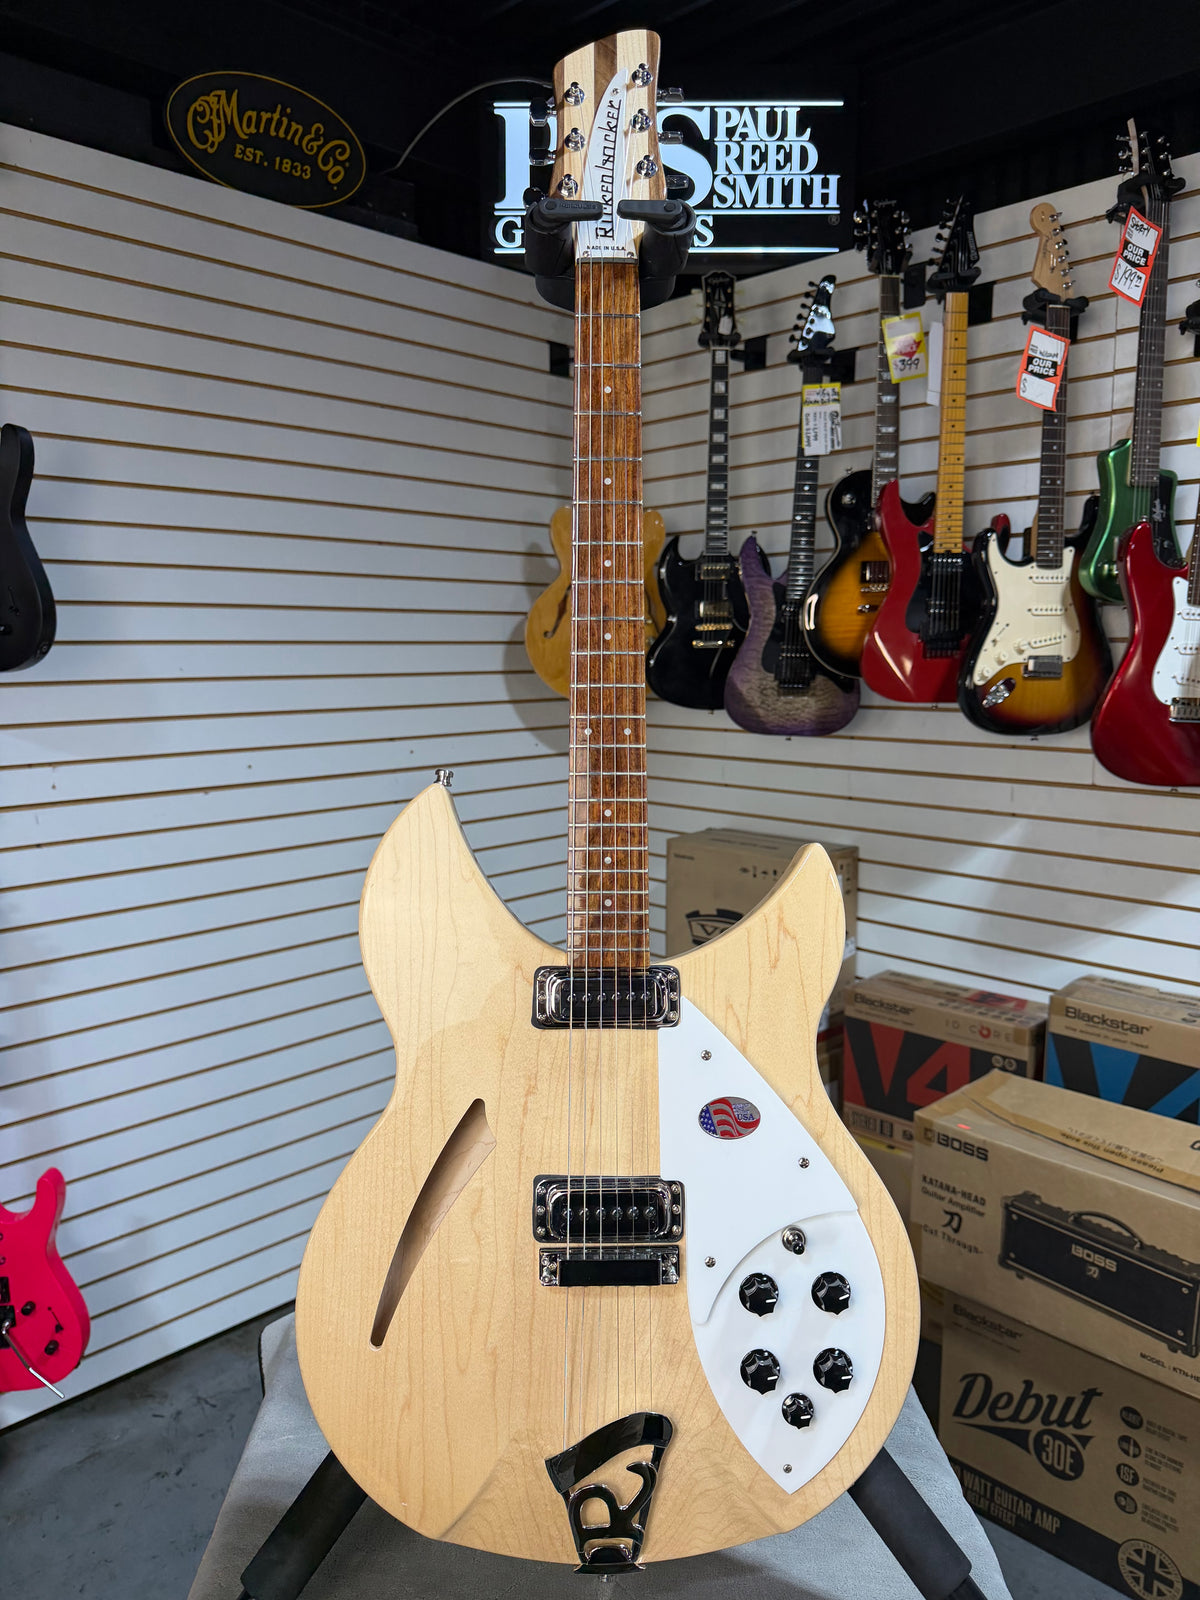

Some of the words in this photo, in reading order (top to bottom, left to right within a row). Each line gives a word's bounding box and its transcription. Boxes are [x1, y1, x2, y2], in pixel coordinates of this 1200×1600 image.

[714, 106, 811, 142] PAUL
[234, 143, 268, 167] EST.
[274, 156, 312, 180] 1833
[594, 99, 622, 242] Rickenbacker
[714, 141, 819, 175] REED
[713, 174, 842, 209] SMITH
[1123, 249, 1147, 267] PRICE
[1127, 243, 1144, 257] OUR
[1028, 364, 1056, 377] PRICE
[1032, 357, 1053, 369] OUR
[853, 992, 914, 1016] Blackstar
[1064, 1005, 1151, 1035] Blackstar
[737, 1113, 755, 1121] USA
[937, 1131, 990, 1162] BOSS
[921, 1186, 946, 1203] Guitar
[947, 1197, 986, 1217] Amplifier
[922, 1174, 987, 1206] KATANA-HEAD
[941, 1209, 963, 1234] 刀
[1071, 1243, 1118, 1273] BOSS
[952, 1303, 1023, 1340] Blackstar
[952, 1372, 1104, 1430] Debut
[1041, 1434, 1076, 1477] 30E
[1119, 1464, 1136, 1485] ISF
[963, 1468, 998, 1500] WATT
[994, 1486, 1033, 1523] GUITAR
[1034, 1508, 1061, 1535] AMP
